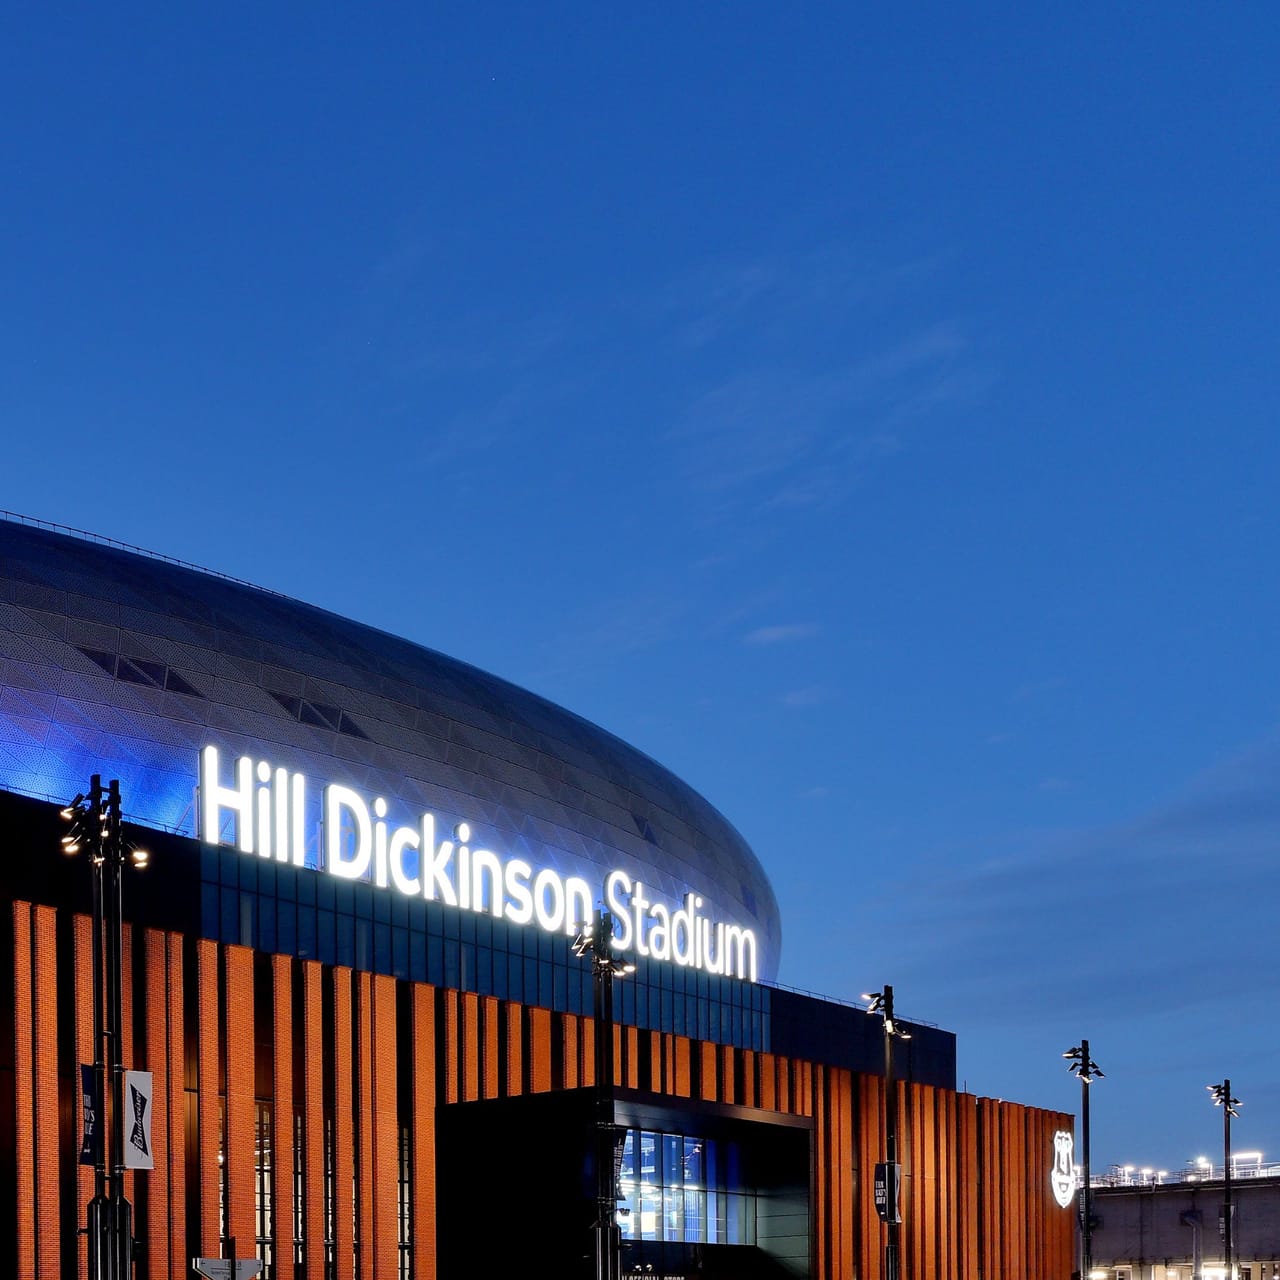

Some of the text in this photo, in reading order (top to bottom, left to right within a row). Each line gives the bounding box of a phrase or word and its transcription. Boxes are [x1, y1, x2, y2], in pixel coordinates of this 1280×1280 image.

[202, 745, 758, 982] Hill Dickinson Stadium
